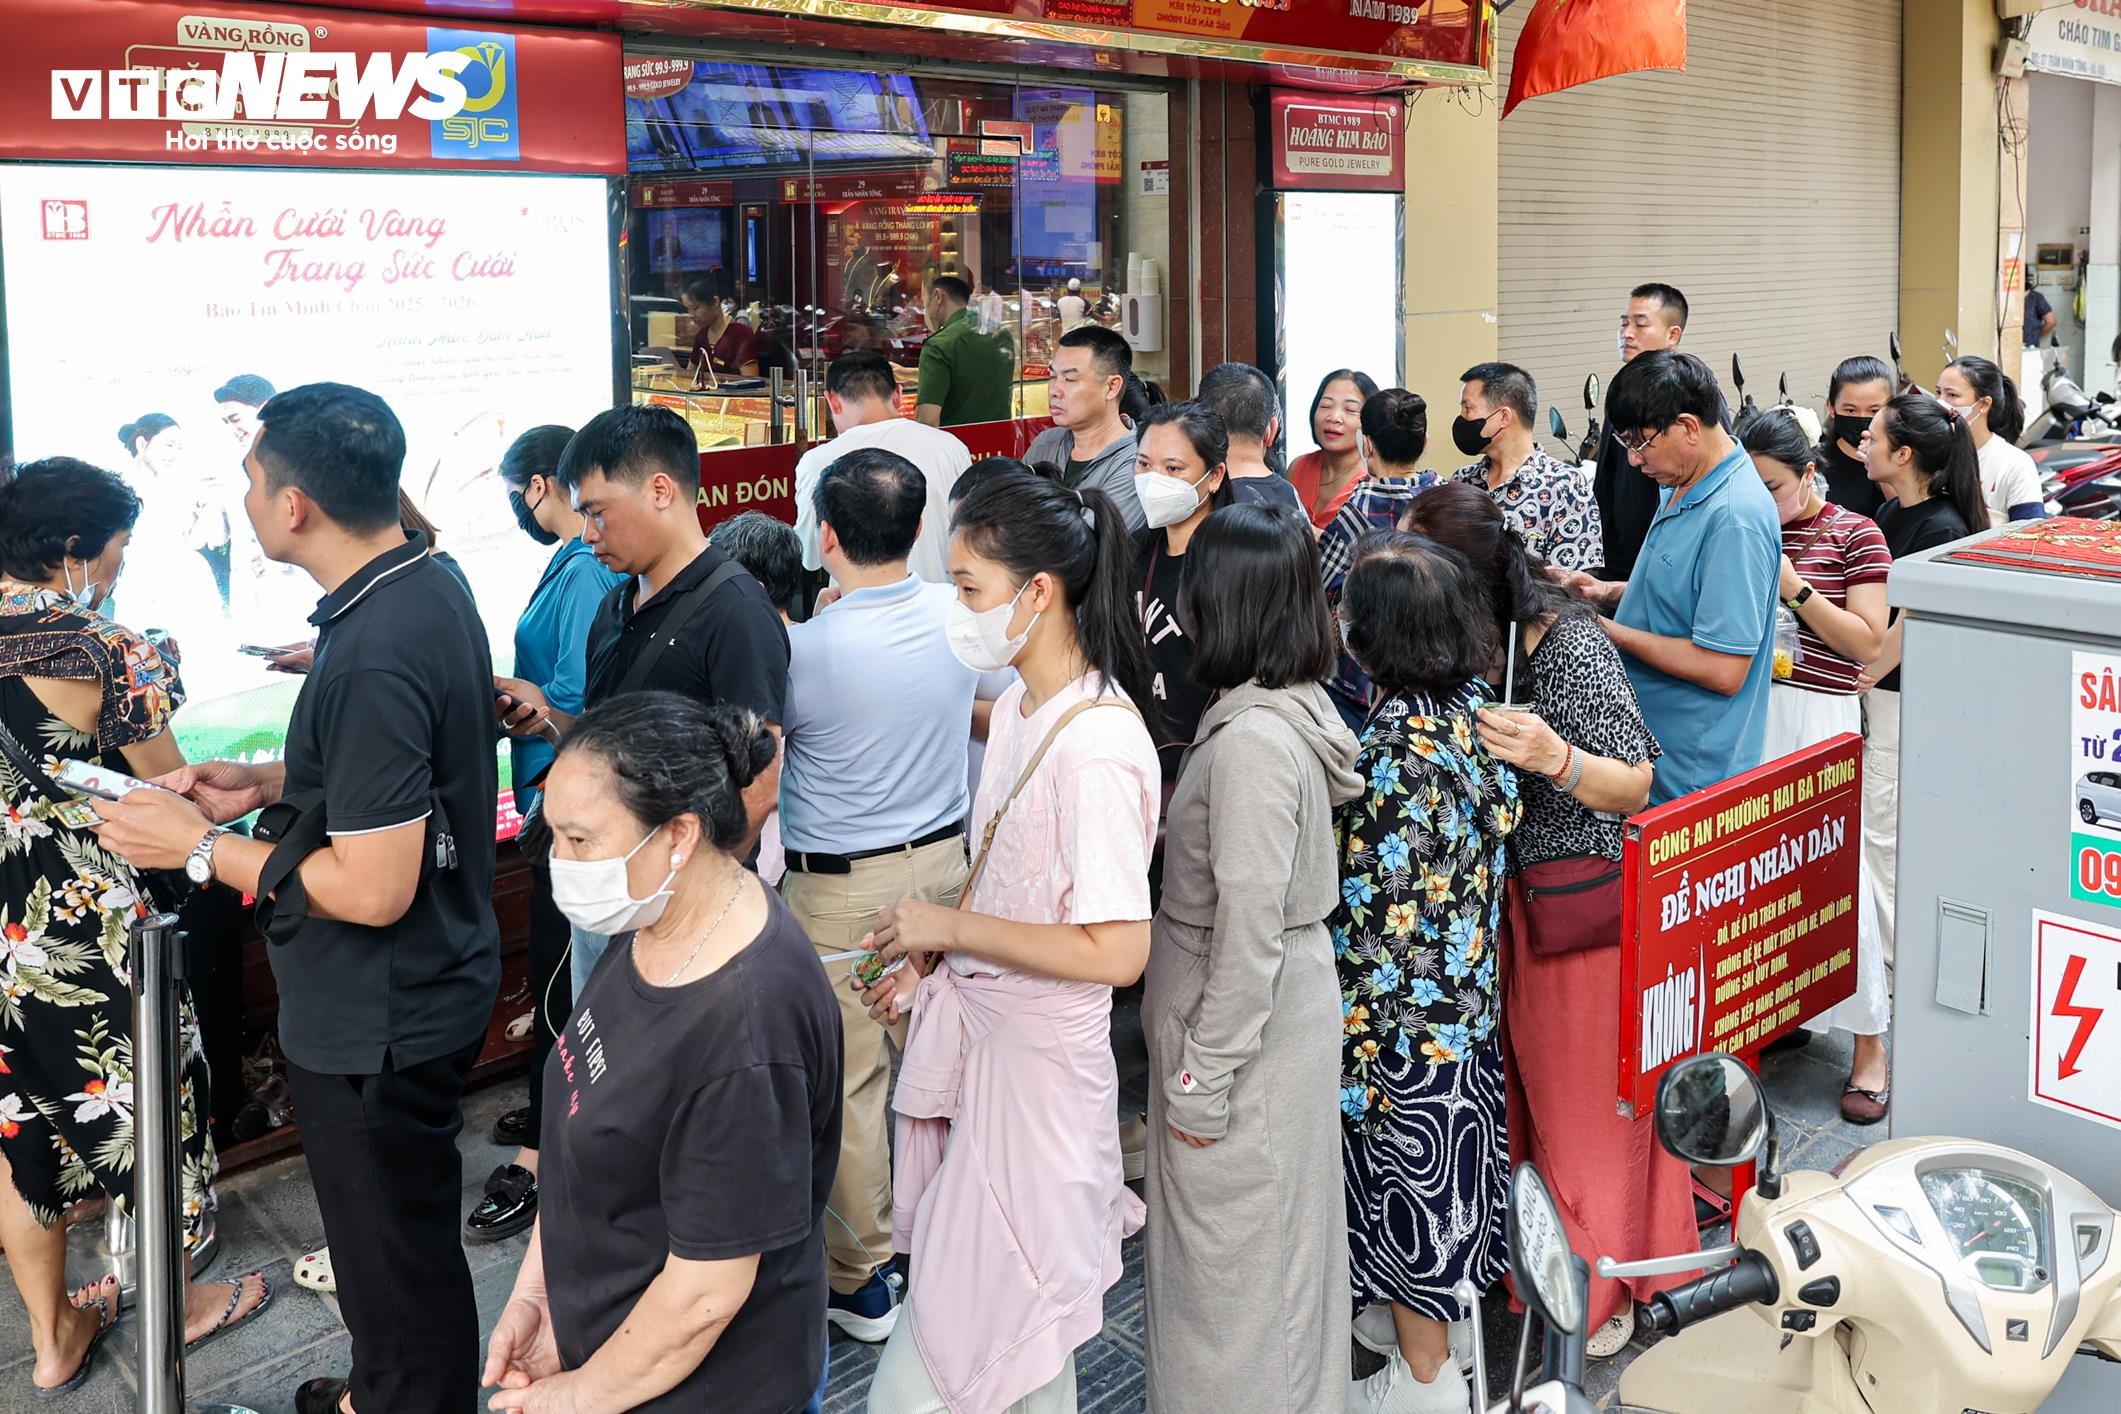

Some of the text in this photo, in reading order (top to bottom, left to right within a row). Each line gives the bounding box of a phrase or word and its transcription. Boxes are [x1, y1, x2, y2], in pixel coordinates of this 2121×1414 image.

[1387, 4, 1419, 25] 1989
[184, 21, 304, 47] VÀNG RỒNG
[2058, 17, 2089, 45] CHÁO
[2092, 27, 2111, 49] TIM
[641, 60, 655, 77] SỨC
[1318, 113, 1361, 127] BTMC 1989
[1289, 123, 1388, 151] HOÀNG KIM BẢO
[1299, 156, 1381, 170] PURE GOLD JEWELRY
[145, 200, 258, 243] Nhẫn
[273, 207, 348, 241] Cưới
[263, 248, 518, 293] Trang Sức Cưới
[735, 474, 789, 505] ĐÓN
[2080, 667, 2121, 714] SÂ
[2081, 734, 2107, 760] TỪ
[1649, 757, 1856, 867] CÔNG AN PHƯỜNG HAI BÀ TRƯNG
[1660, 813, 1846, 932] ĐỀ NGHỊ NHÂN DÂN
[1759, 900, 1777, 927] TRÊN
[1715, 953, 1742, 981] KHÔNG
[1753, 942, 1763, 962] XE
[1779, 922, 1797, 948] TRÊN
[1836, 893, 1852, 917] LÒNG
[1713, 1010, 1740, 1039] KHÔNG
[1755, 990, 1774, 1017] HÀNG
[1811, 960, 1829, 984] LÒNG
[1641, 961, 1696, 1075] KHÔNG
[1760, 1011, 1777, 1037] GIAO
[1778, 998, 1801, 1026] THÔNG
[2003, 1226, 2017, 1234] 120
